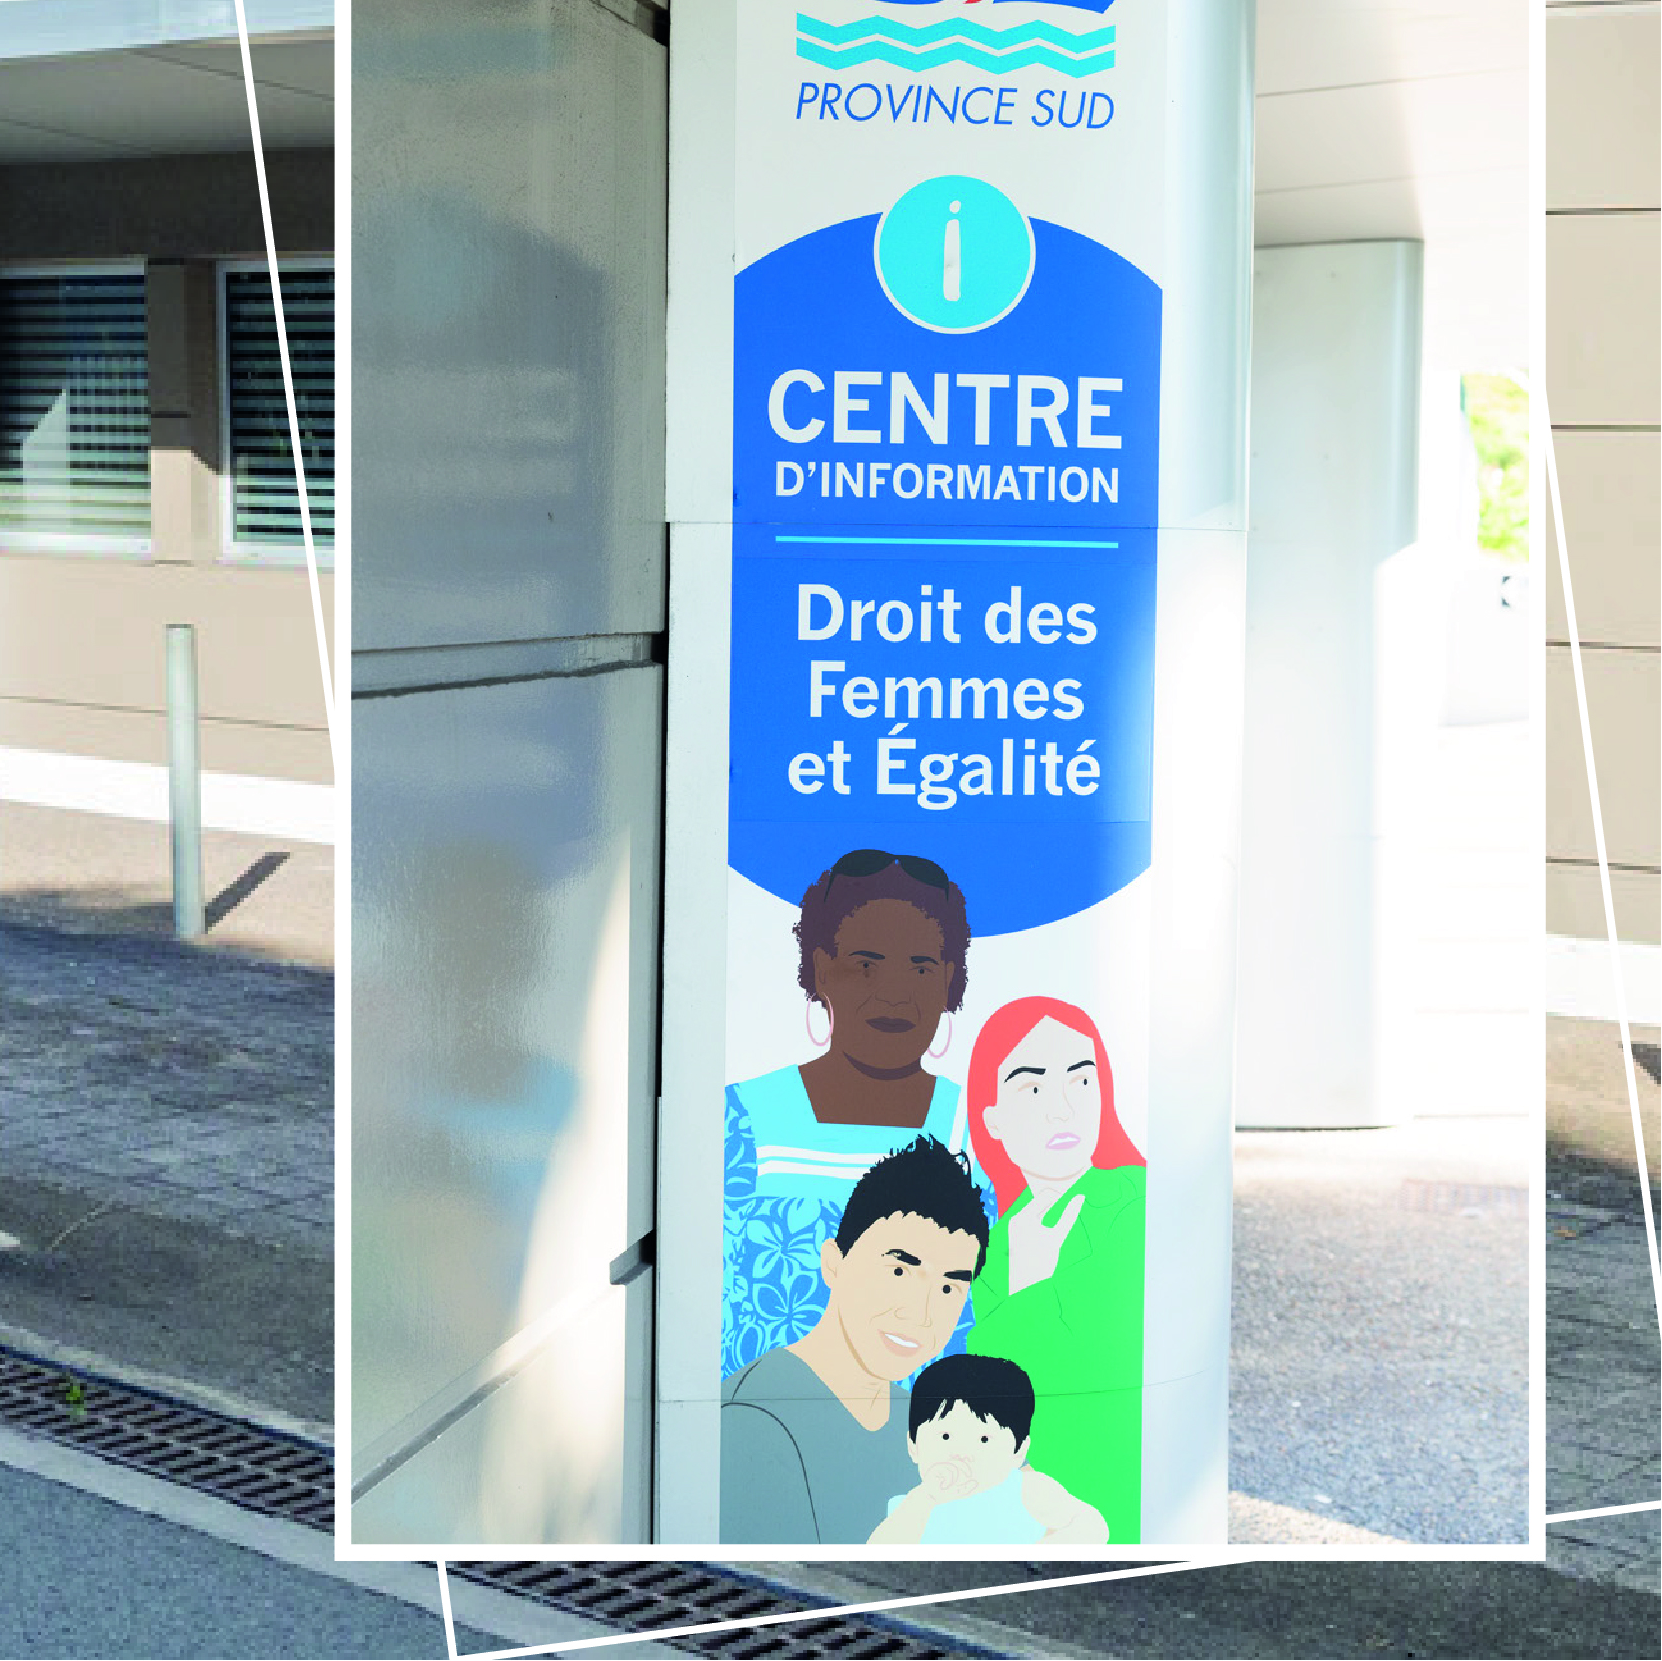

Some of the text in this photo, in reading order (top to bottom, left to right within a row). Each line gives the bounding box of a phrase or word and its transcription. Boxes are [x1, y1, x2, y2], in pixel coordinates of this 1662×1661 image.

[796, 82, 1115, 129] PROVINCE SUD
[767, 369, 1123, 449] CENTRE
[775, 461, 1119, 503] D’INFORMATION
[797, 583, 1097, 645] Droit des
[810, 659, 1085, 720] Femmes
[788, 722, 1101, 811] et Égalité
